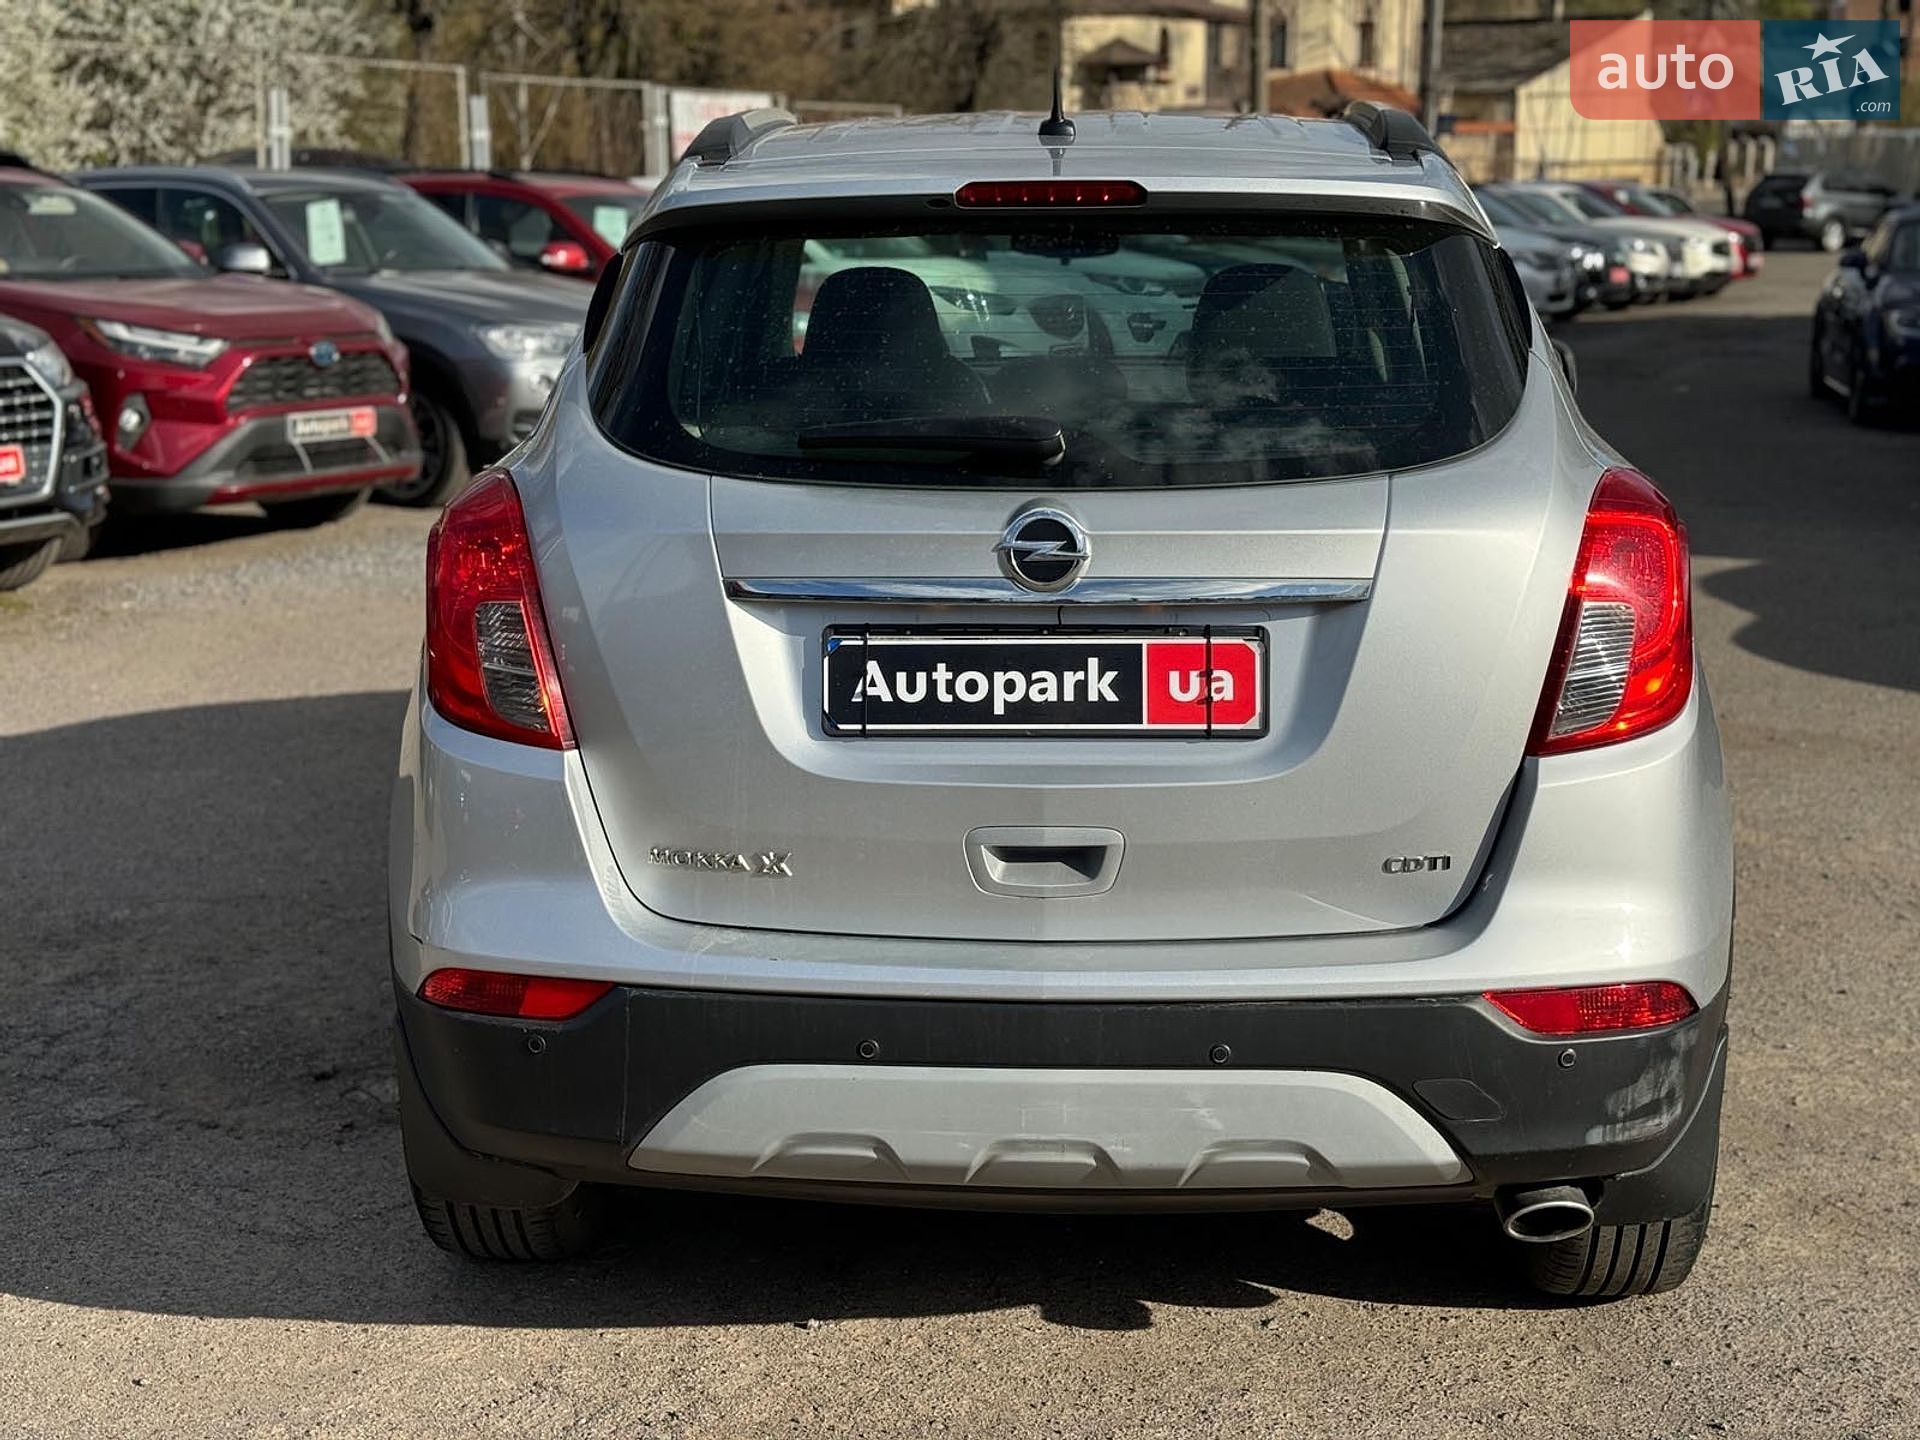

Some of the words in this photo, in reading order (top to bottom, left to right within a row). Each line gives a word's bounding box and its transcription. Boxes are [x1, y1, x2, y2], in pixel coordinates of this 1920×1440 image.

[851, 657, 1119, 715] Autopark
[1168, 669, 1235, 702] ua
[650, 849, 750, 871] MOKKA
[1382, 855, 1450, 873] CDTI
